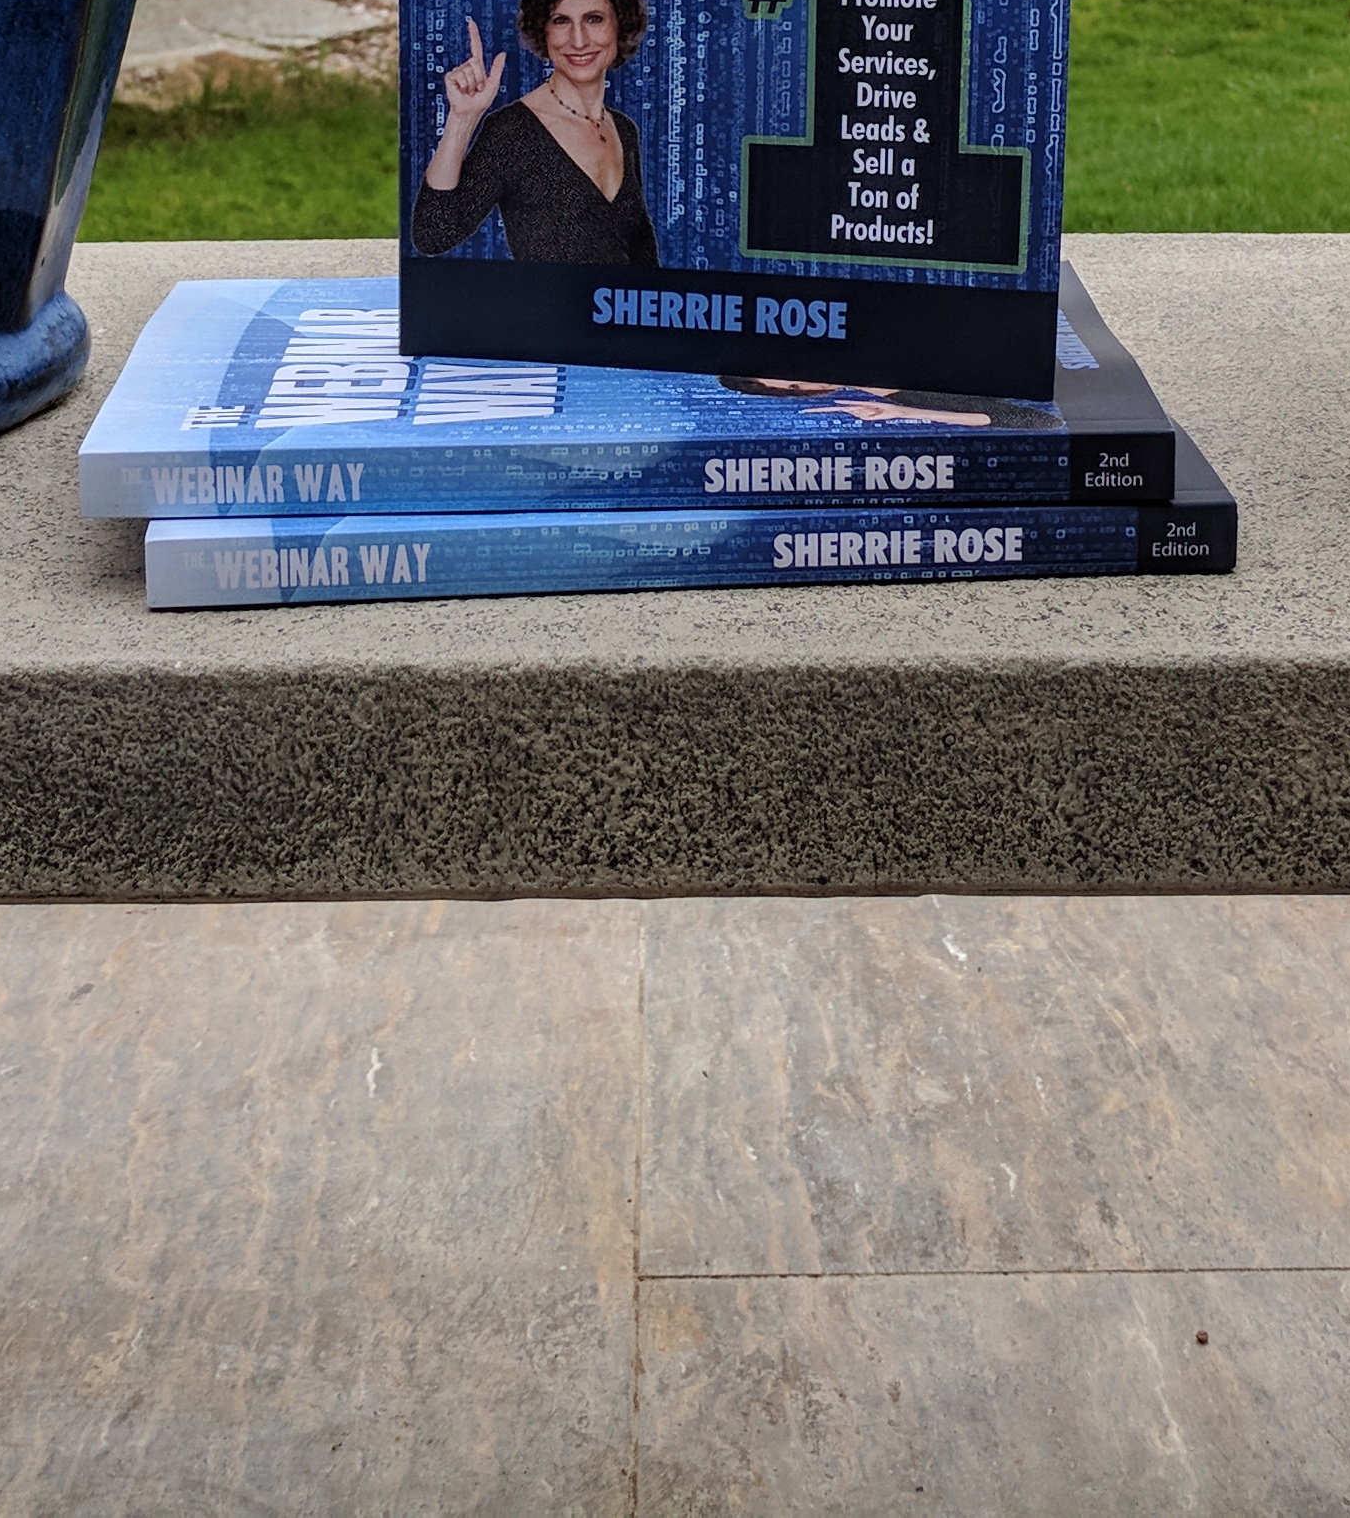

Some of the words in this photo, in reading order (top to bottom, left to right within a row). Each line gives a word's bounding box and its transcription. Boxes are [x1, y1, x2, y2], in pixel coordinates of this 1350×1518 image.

[861, 15, 914, 42] Your
[838, 47, 936, 81] Services,
[857, 81, 917, 109] Drive
[841, 114, 906, 142] Leads
[913, 118, 931, 144] &
[853, 148, 894, 176] Sell
[847, 181, 889, 209] Ton
[896, 183, 920, 210] of
[831, 214, 934, 245] Products!
[592, 288, 743, 332] SHERRIE
[756, 299, 847, 340] ROSE
[412, 363, 559, 425] WAY
[180, 404, 247, 431] THE
[704, 457, 852, 493] SHERRIE
[864, 455, 954, 490] ROSE
[1099, 452, 1130, 468] 2nd
[151, 463, 285, 505] WEBINAR
[293, 463, 364, 503] WAY
[1084, 470, 1144, 488] Edition
[1166, 522, 1197, 538] 2nd
[773, 530, 921, 568] SHERRIE
[934, 527, 1023, 562] ROSE
[1152, 541, 1210, 557] Edition
[213, 545, 349, 589] WEBINAR
[359, 543, 431, 584] WAY
